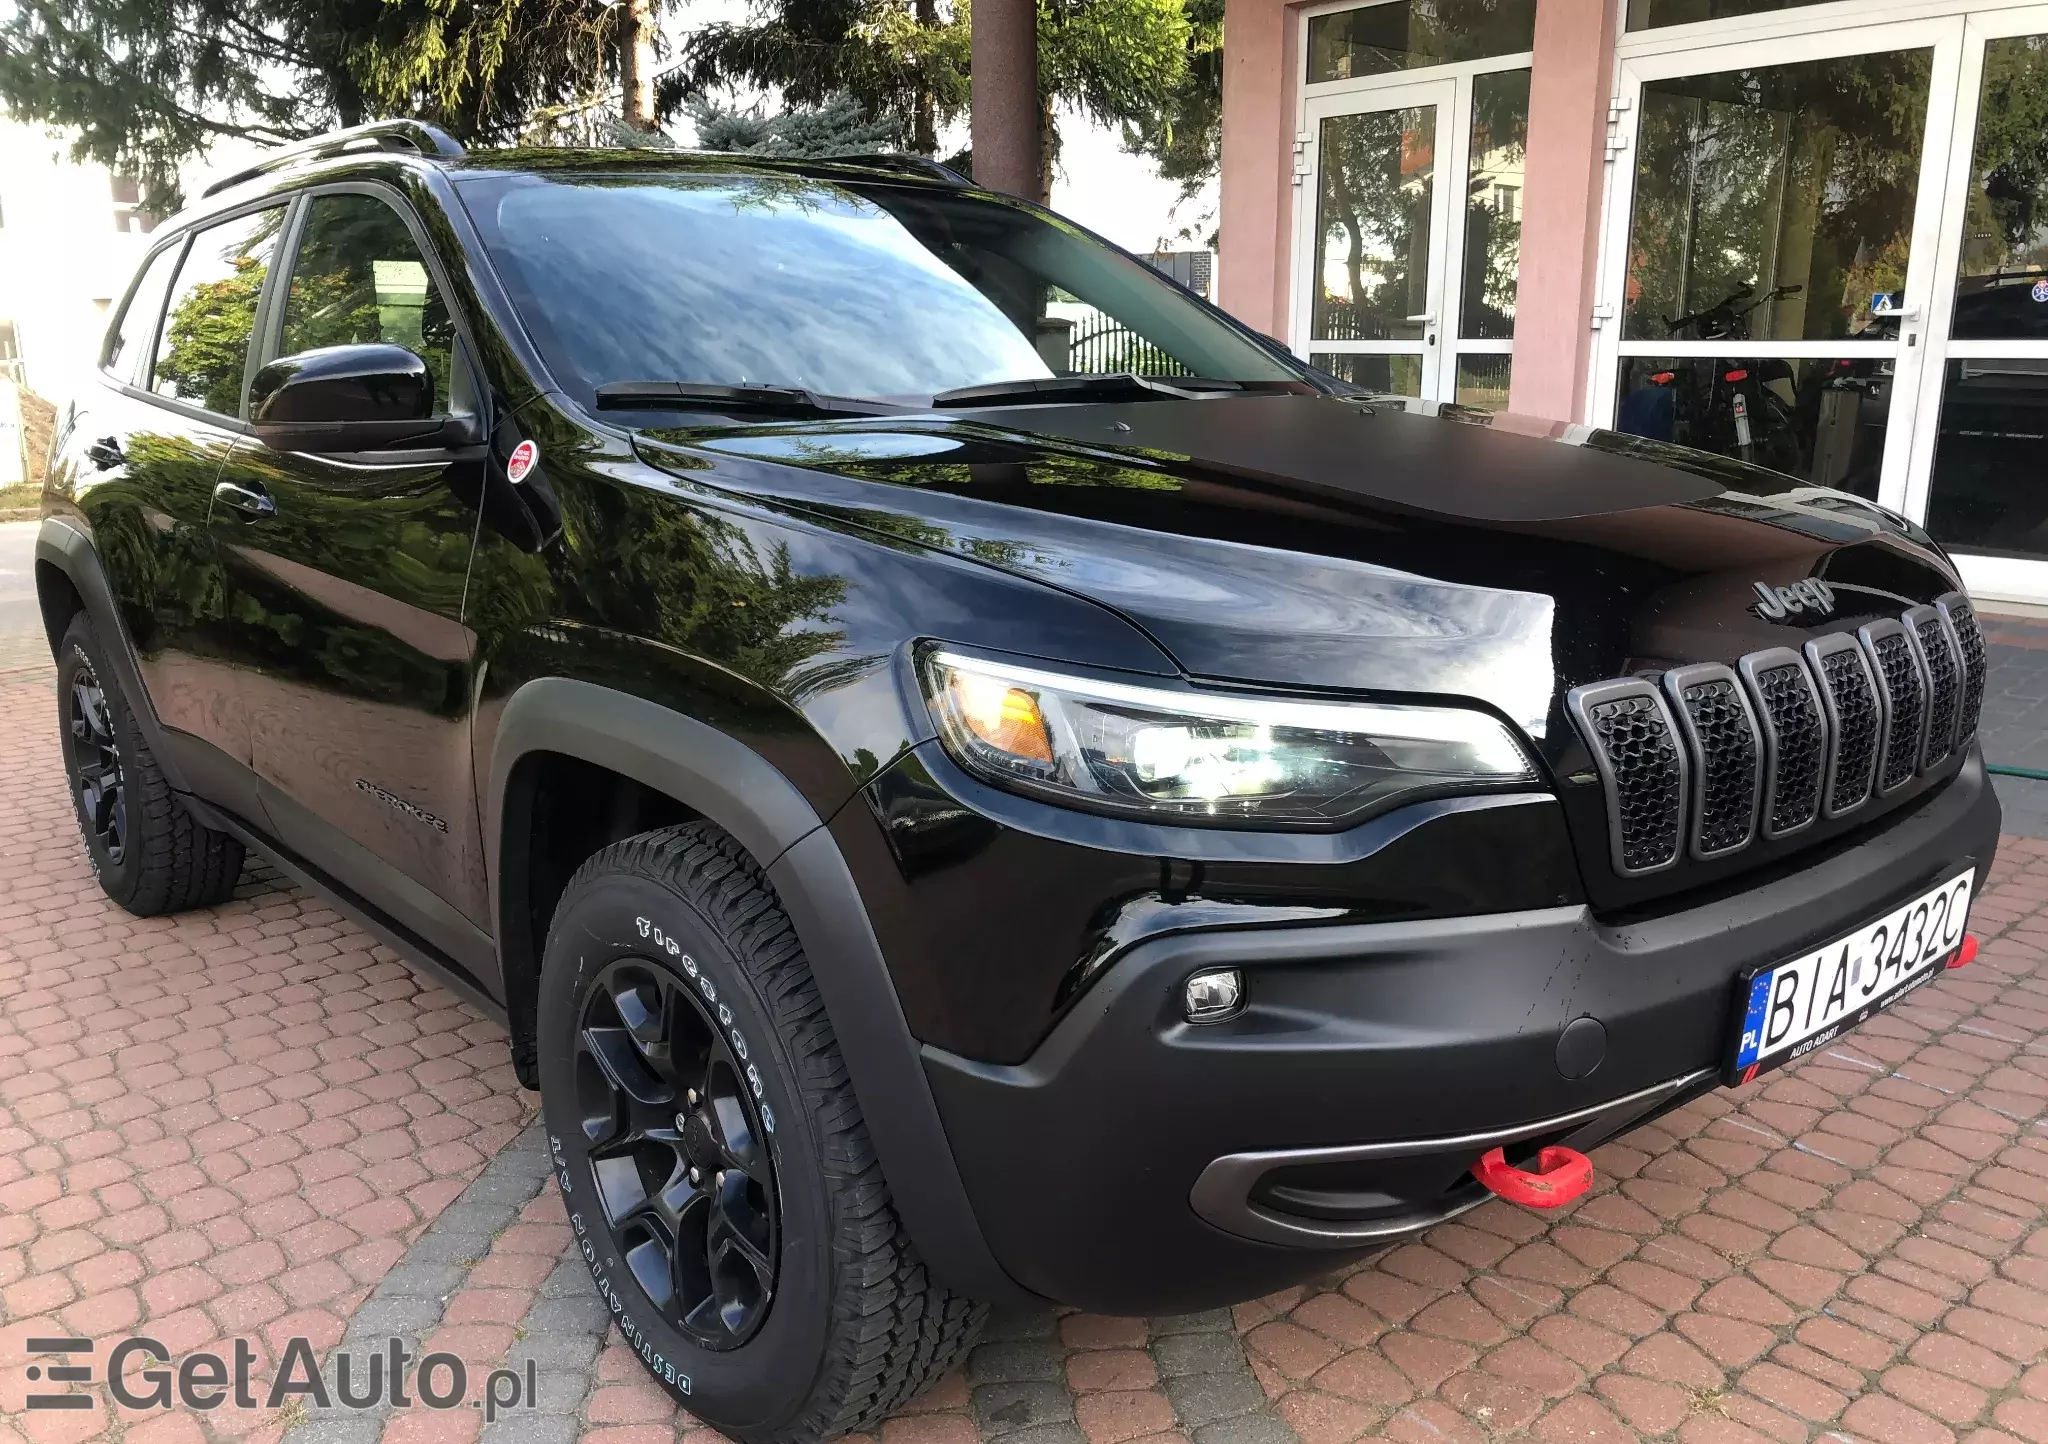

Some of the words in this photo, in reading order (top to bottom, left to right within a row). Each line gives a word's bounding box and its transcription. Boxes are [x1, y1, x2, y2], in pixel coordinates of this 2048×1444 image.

[1752, 577, 1835, 619] Jeep
[1764, 943, 1849, 1049] BIA
[1862, 879, 1968, 997] 3432C
[1740, 1029, 1758, 1054] PL
[1789, 1039, 1813, 1060] AUTO
[1813, 1025, 1839, 1048] ADART
[571, 1213, 692, 1396] DESTINATION
